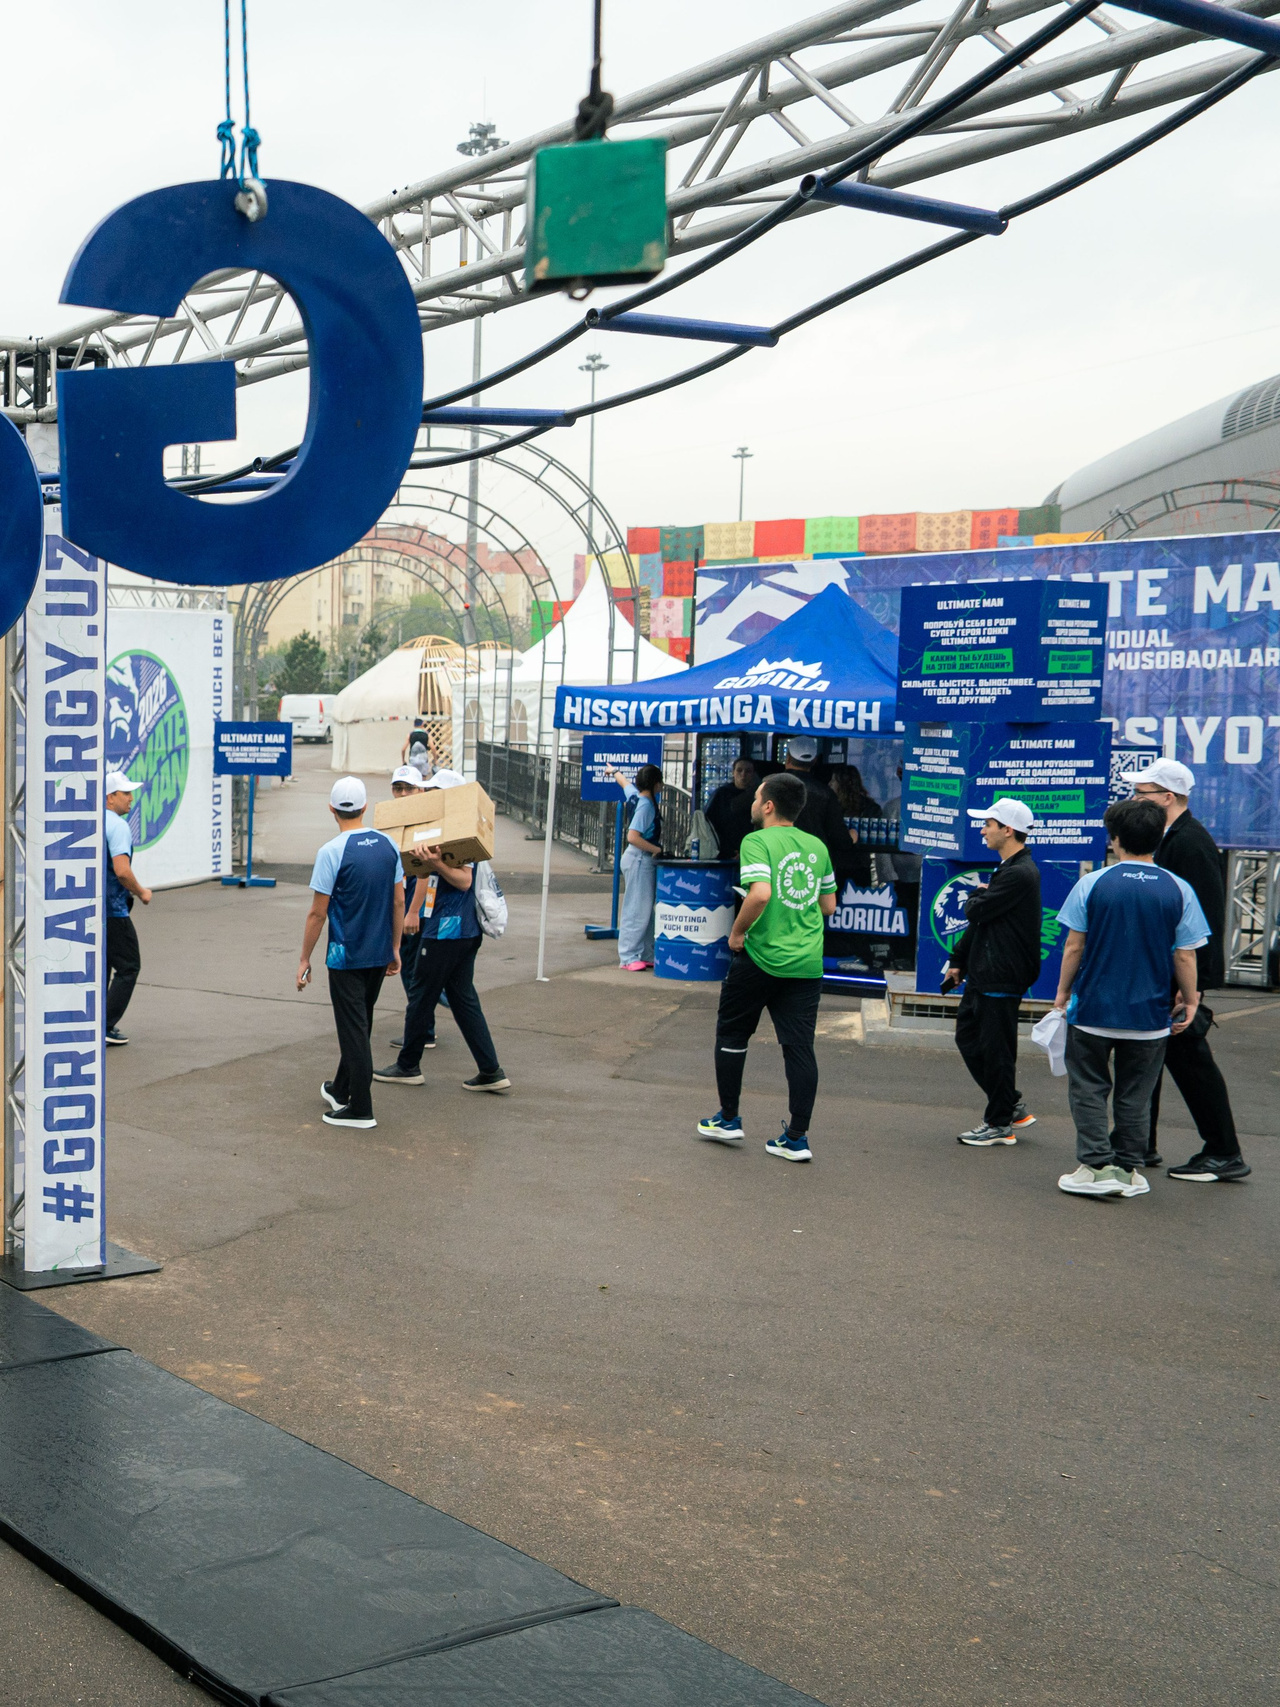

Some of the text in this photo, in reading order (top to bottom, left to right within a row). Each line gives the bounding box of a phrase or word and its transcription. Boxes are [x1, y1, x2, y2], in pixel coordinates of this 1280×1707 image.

[937, 597, 1004, 610] ULTIMATE MAN
[923, 617, 1017, 629] ПОПРОБУЙ СЕБЯ В РОЛИ
[930, 627, 1008, 638] СУПЕР ГЕРОЯ ГОНКИ
[941, 636, 996, 646] ULTIMATE MAN
[930, 652, 1006, 663] КАКИМ ТЫ БУДЕШЬ
[926, 660, 1010, 671] НА ЭТОЙ ДИСТАНЦИИ?
[713, 668, 830, 692] GORILLA
[902, 679, 938, 689] СИЛЬНЕЕ.
[939, 678, 978, 688] БЫСТРЕЕ.
[979, 677, 1035, 687] ВЫНОСЛИВЕЕ.
[923, 686, 1011, 696] ГОТОВ ЛИ ТЫ УВИДЕТЬ
[138, 667, 167, 742] 2026
[937, 696, 997, 705] СЕБЯ ДРУГИМ?
[563, 694, 881, 732] HISSIYOTINGA KUCH
[221, 733, 285, 743] ULTIMATE MAN
[211, 618, 223, 873] HISSIYOT KUCH BER
[1010, 739, 1075, 749] ULTIMATE MAN
[594, 753, 648, 763] ULTIMATE MAN
[989, 760, 1094, 768] ULTIMATE MAN POYGASINING
[1006, 768, 1076, 777] SUPER QAHRAMONI
[976, 776, 1010, 786] SIFATIDA
[1050, 776, 1074, 785] SINAB
[1075, 776, 1106, 785] KO'RING
[140, 747, 188, 844] MAN
[1037, 836, 1093, 845] TAYYORMISAN?
[43, 534, 98, 1223] #GORILLAENERGY.UZ
[661, 914, 707, 924] HISSIYOTINGA
[829, 905, 906, 935] GORILLA
[663, 923, 699, 933] KUCH BER
